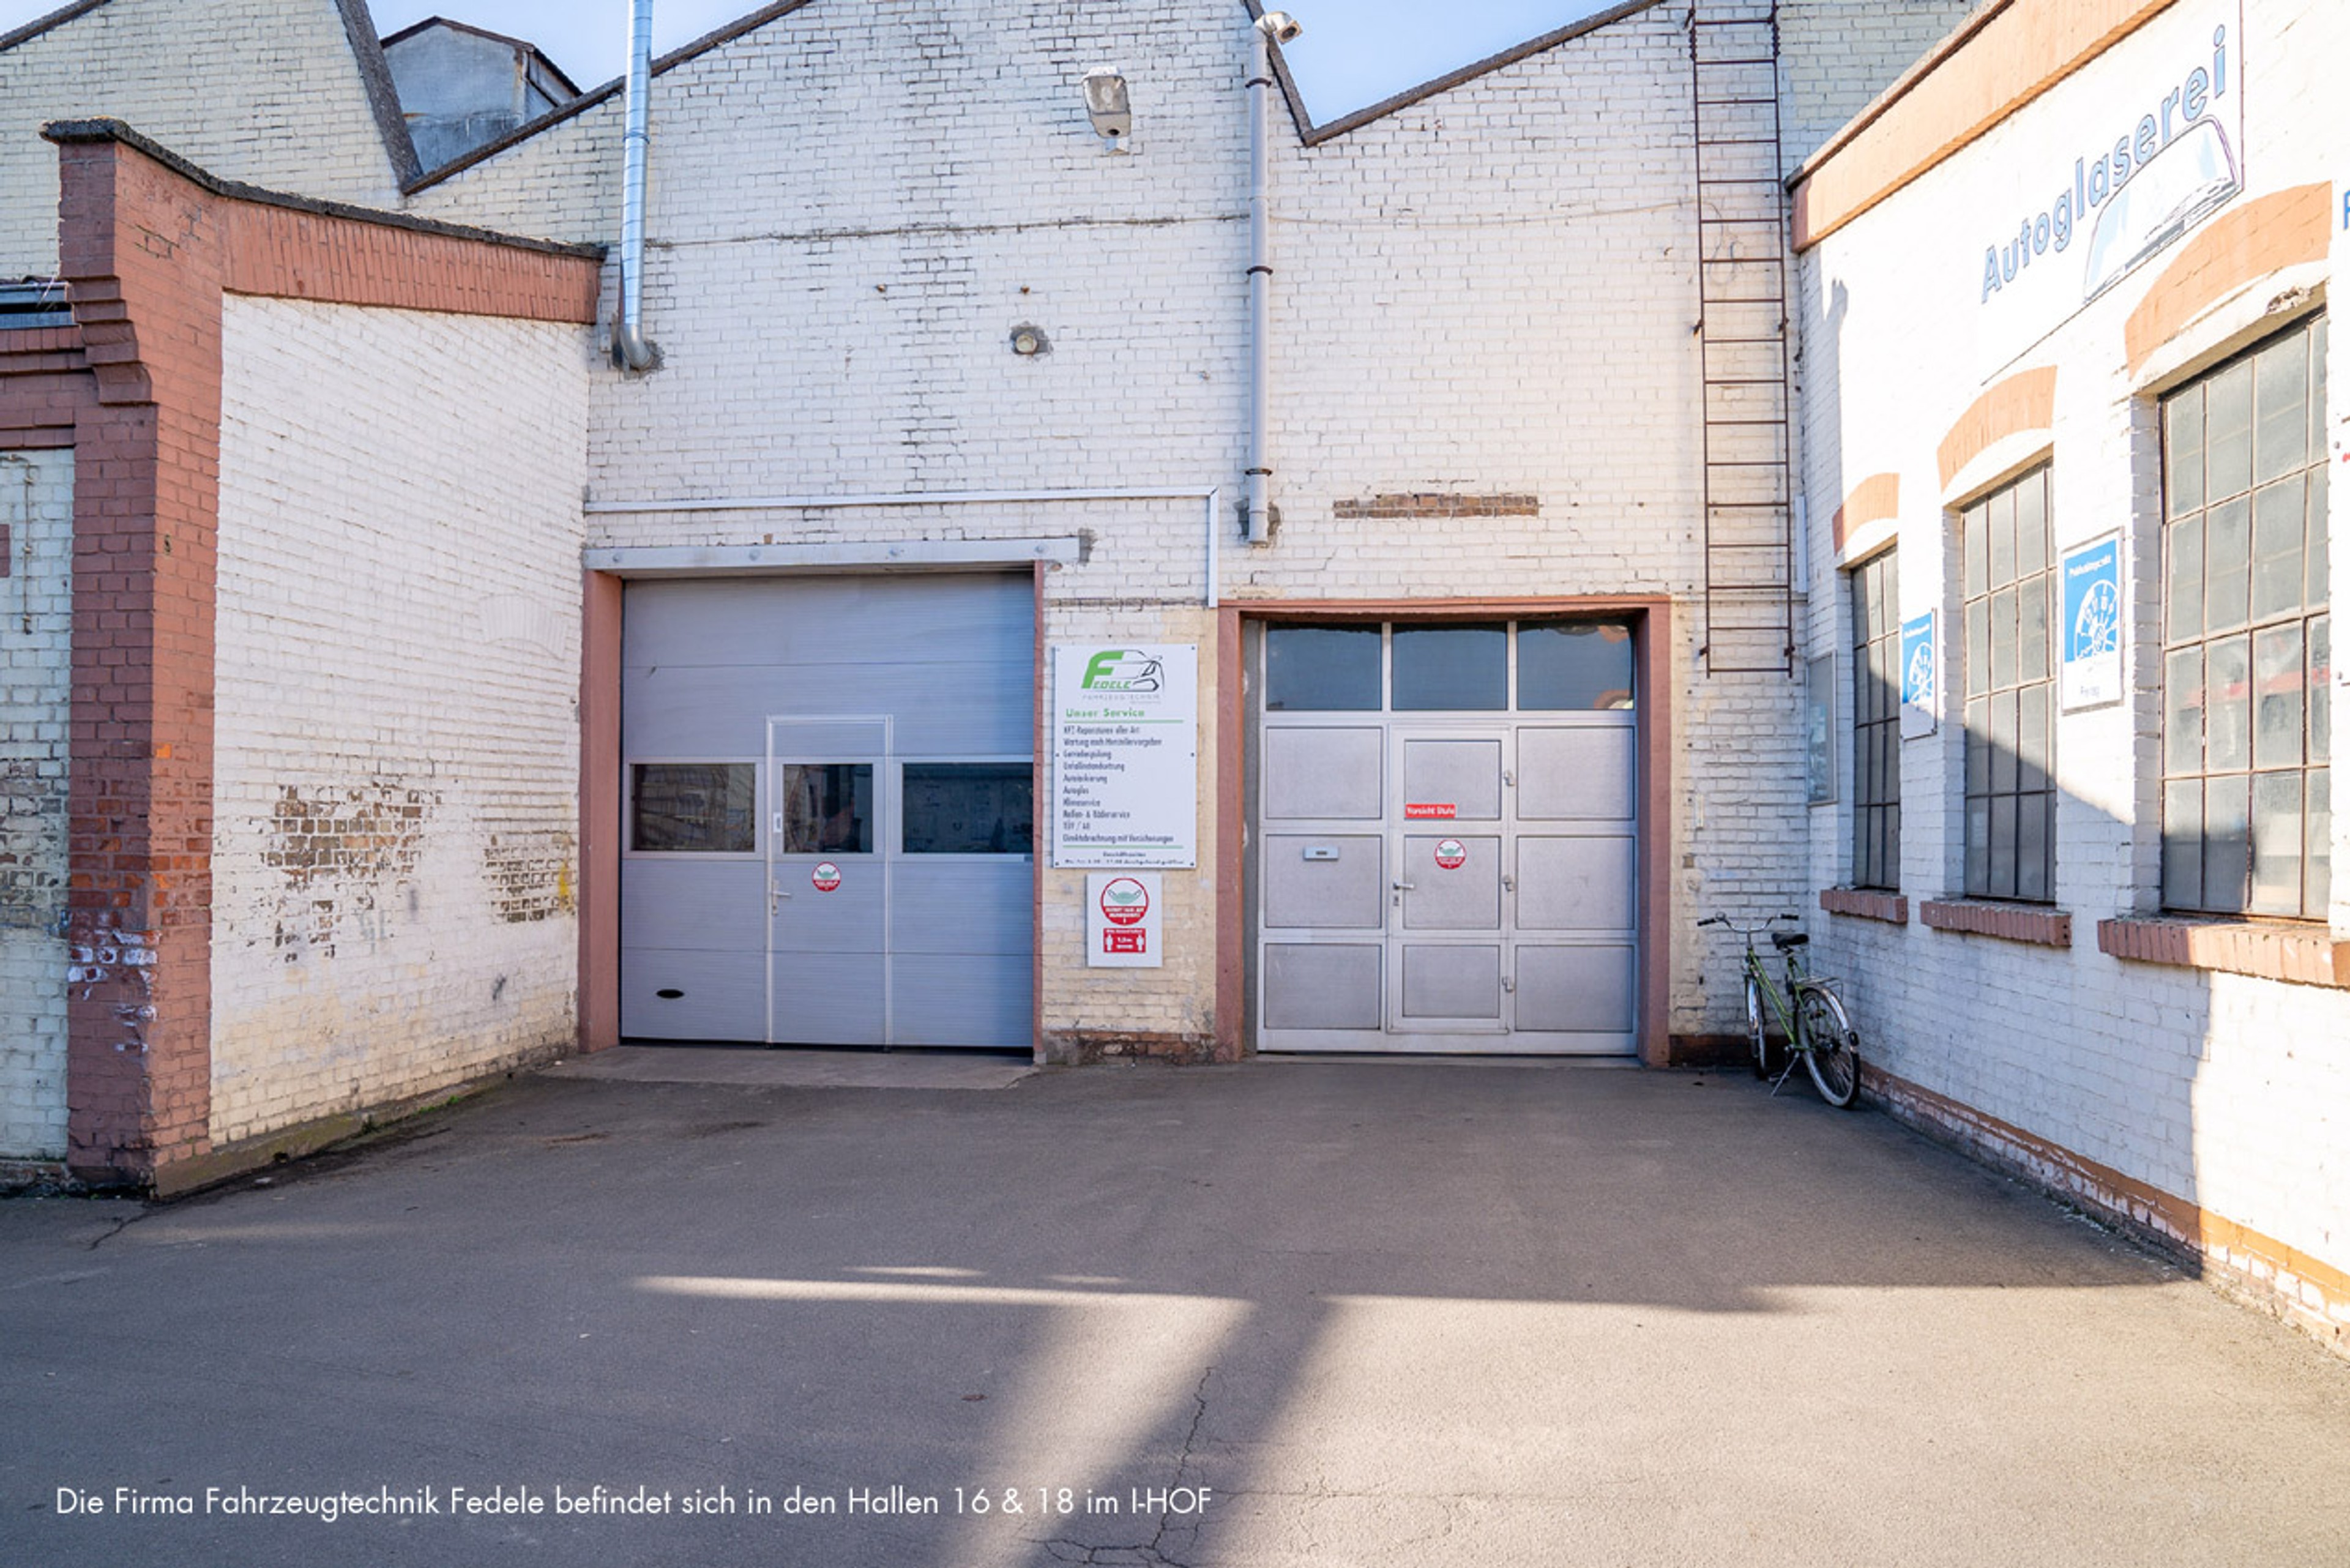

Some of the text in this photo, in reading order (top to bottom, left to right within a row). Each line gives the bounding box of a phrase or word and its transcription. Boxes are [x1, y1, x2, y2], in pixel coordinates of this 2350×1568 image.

[1981, 24, 2226, 305] Autoglaserei
[1065, 707, 1145, 717] Unser Service
